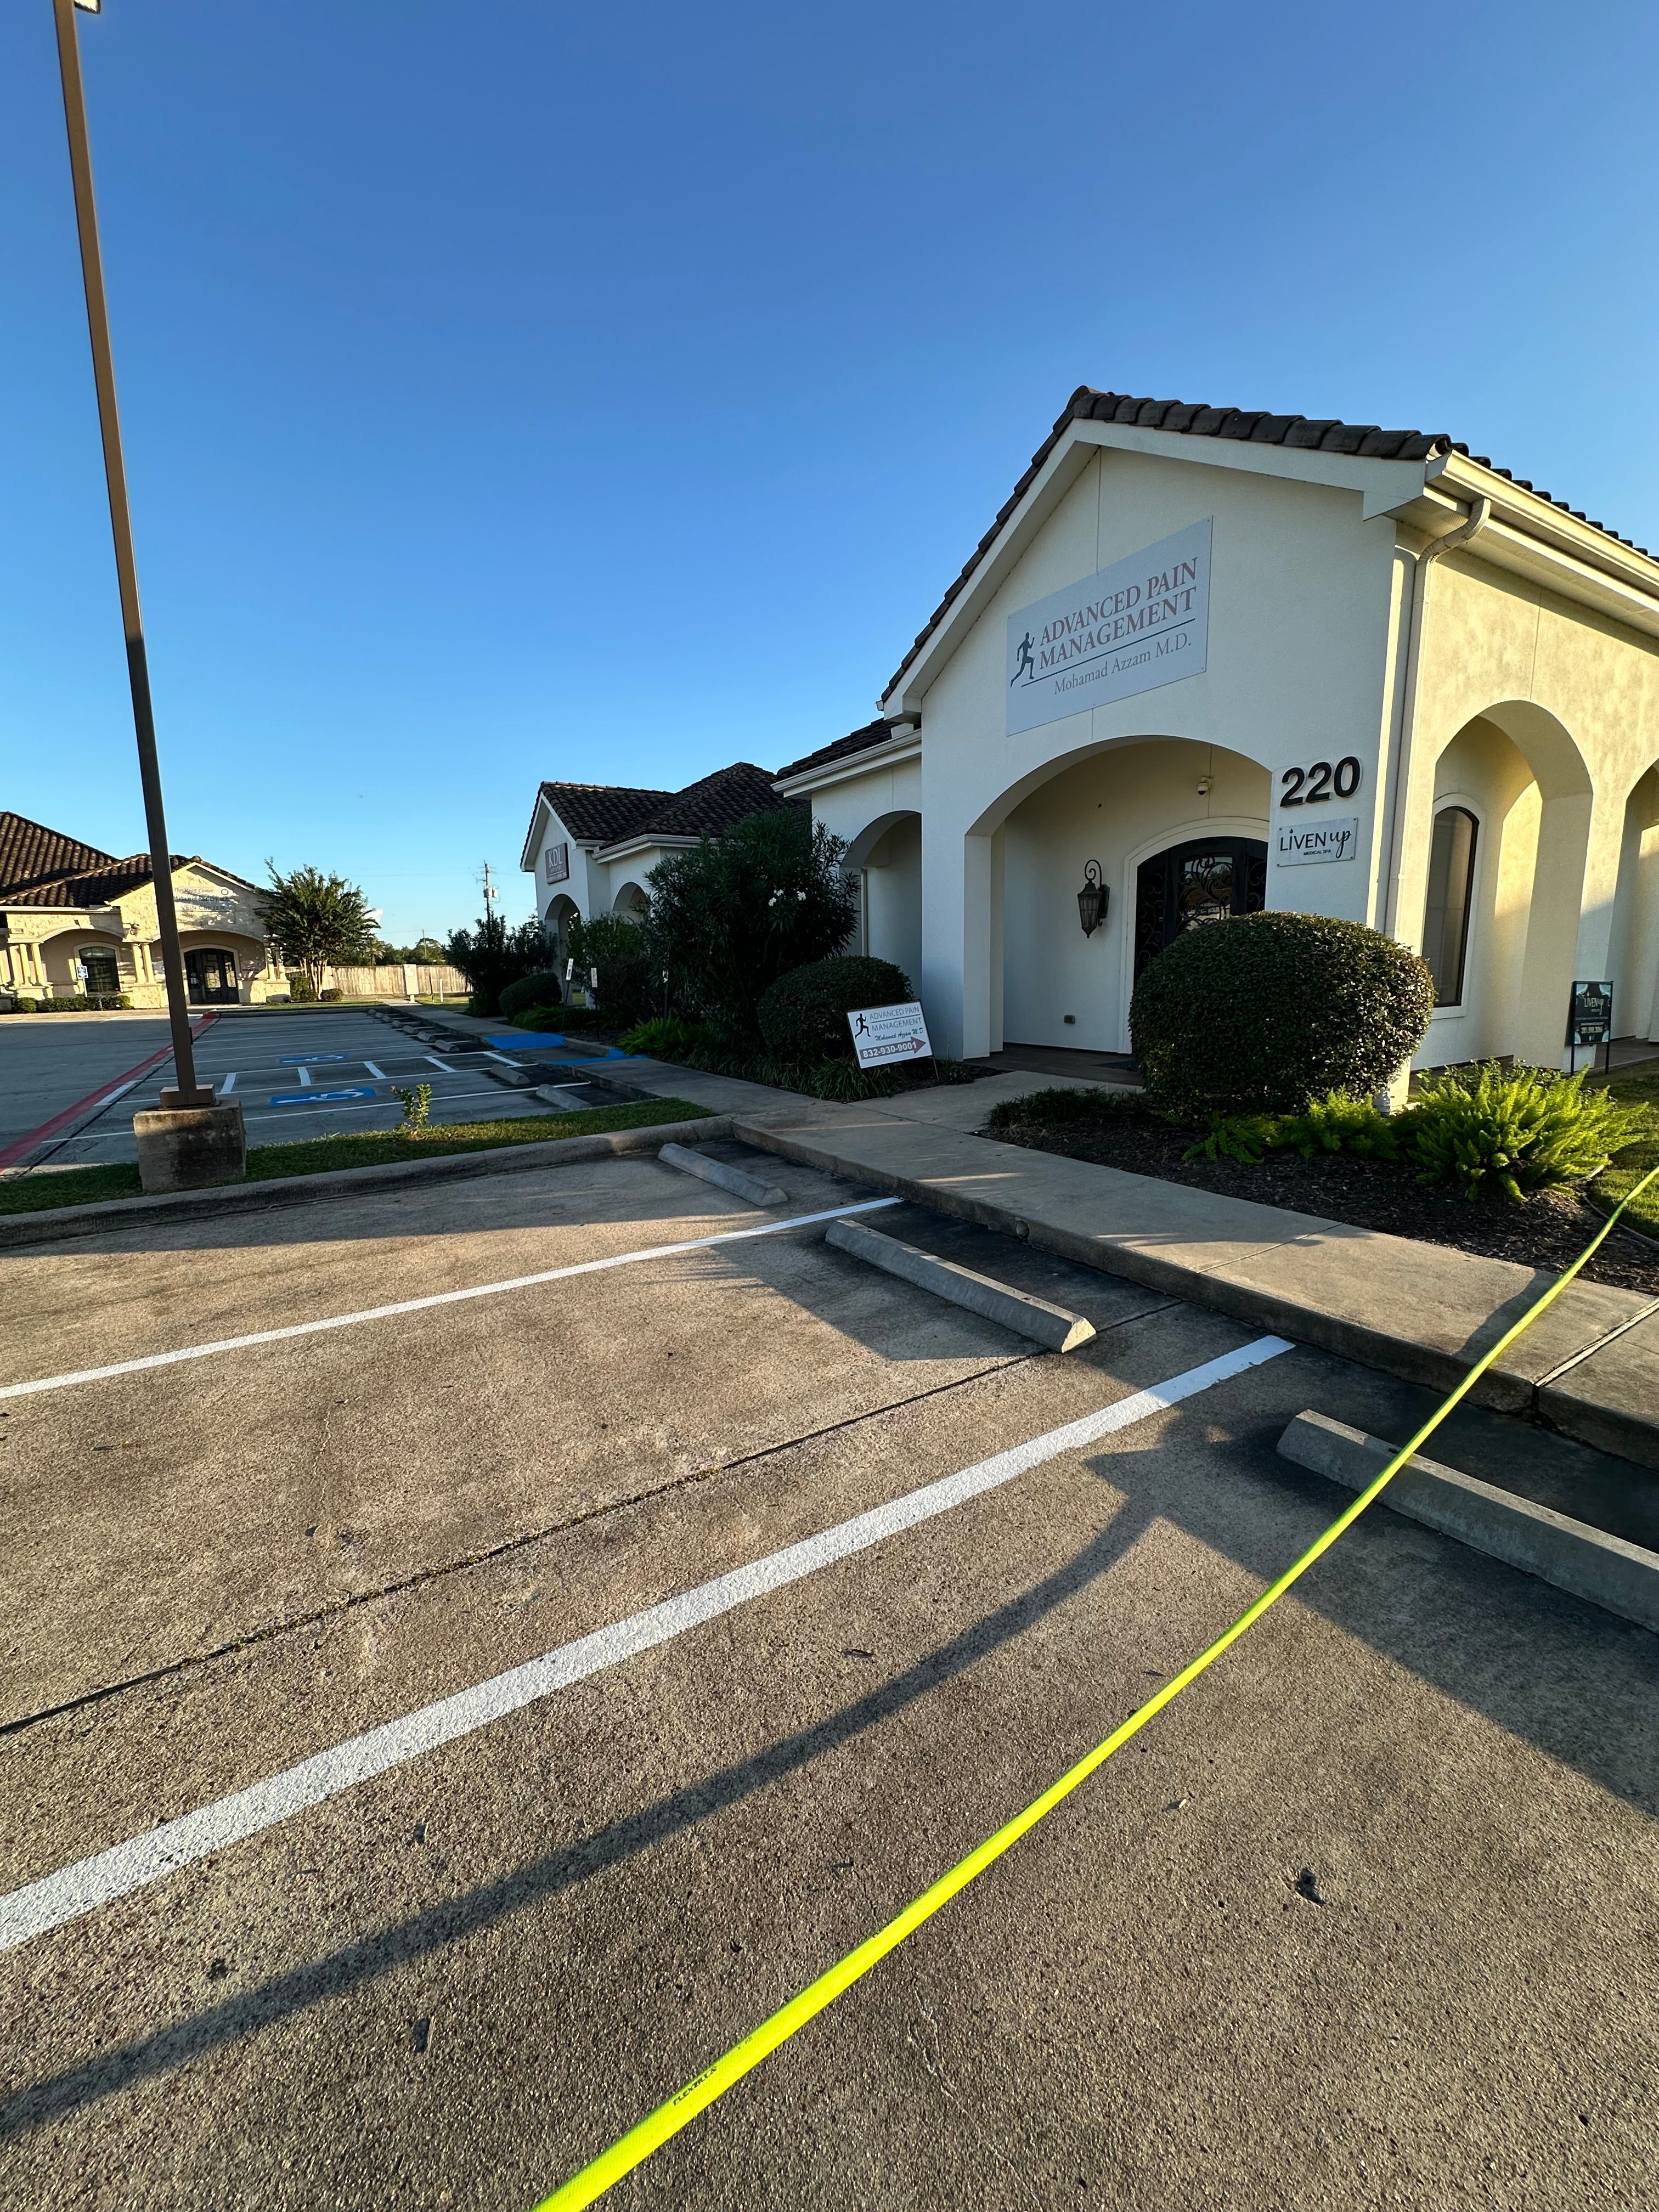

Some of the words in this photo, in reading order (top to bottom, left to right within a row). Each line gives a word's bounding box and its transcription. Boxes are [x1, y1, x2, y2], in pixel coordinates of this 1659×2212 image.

[1040, 585, 1141, 646] ADVANCED
[1146, 557, 1199, 600] PAIN
[1039, 586, 1197, 670] MANAGEMENT
[1053, 663, 1108, 695] Mohamad
[1111, 649, 1151, 674] Azzam
[1155, 632, 1192, 658] M.D.
[1280, 756, 1362, 807] 220
[548, 847, 562, 868] KDL
[1327, 830, 1352, 859] up
[870, 1008, 904, 1020] ADVANCED
[905, 1006, 919, 1014] PAIN
[871, 1017, 922, 1032] MANAGEMENT
[862, 1041, 917, 1058] 832-930-9001
